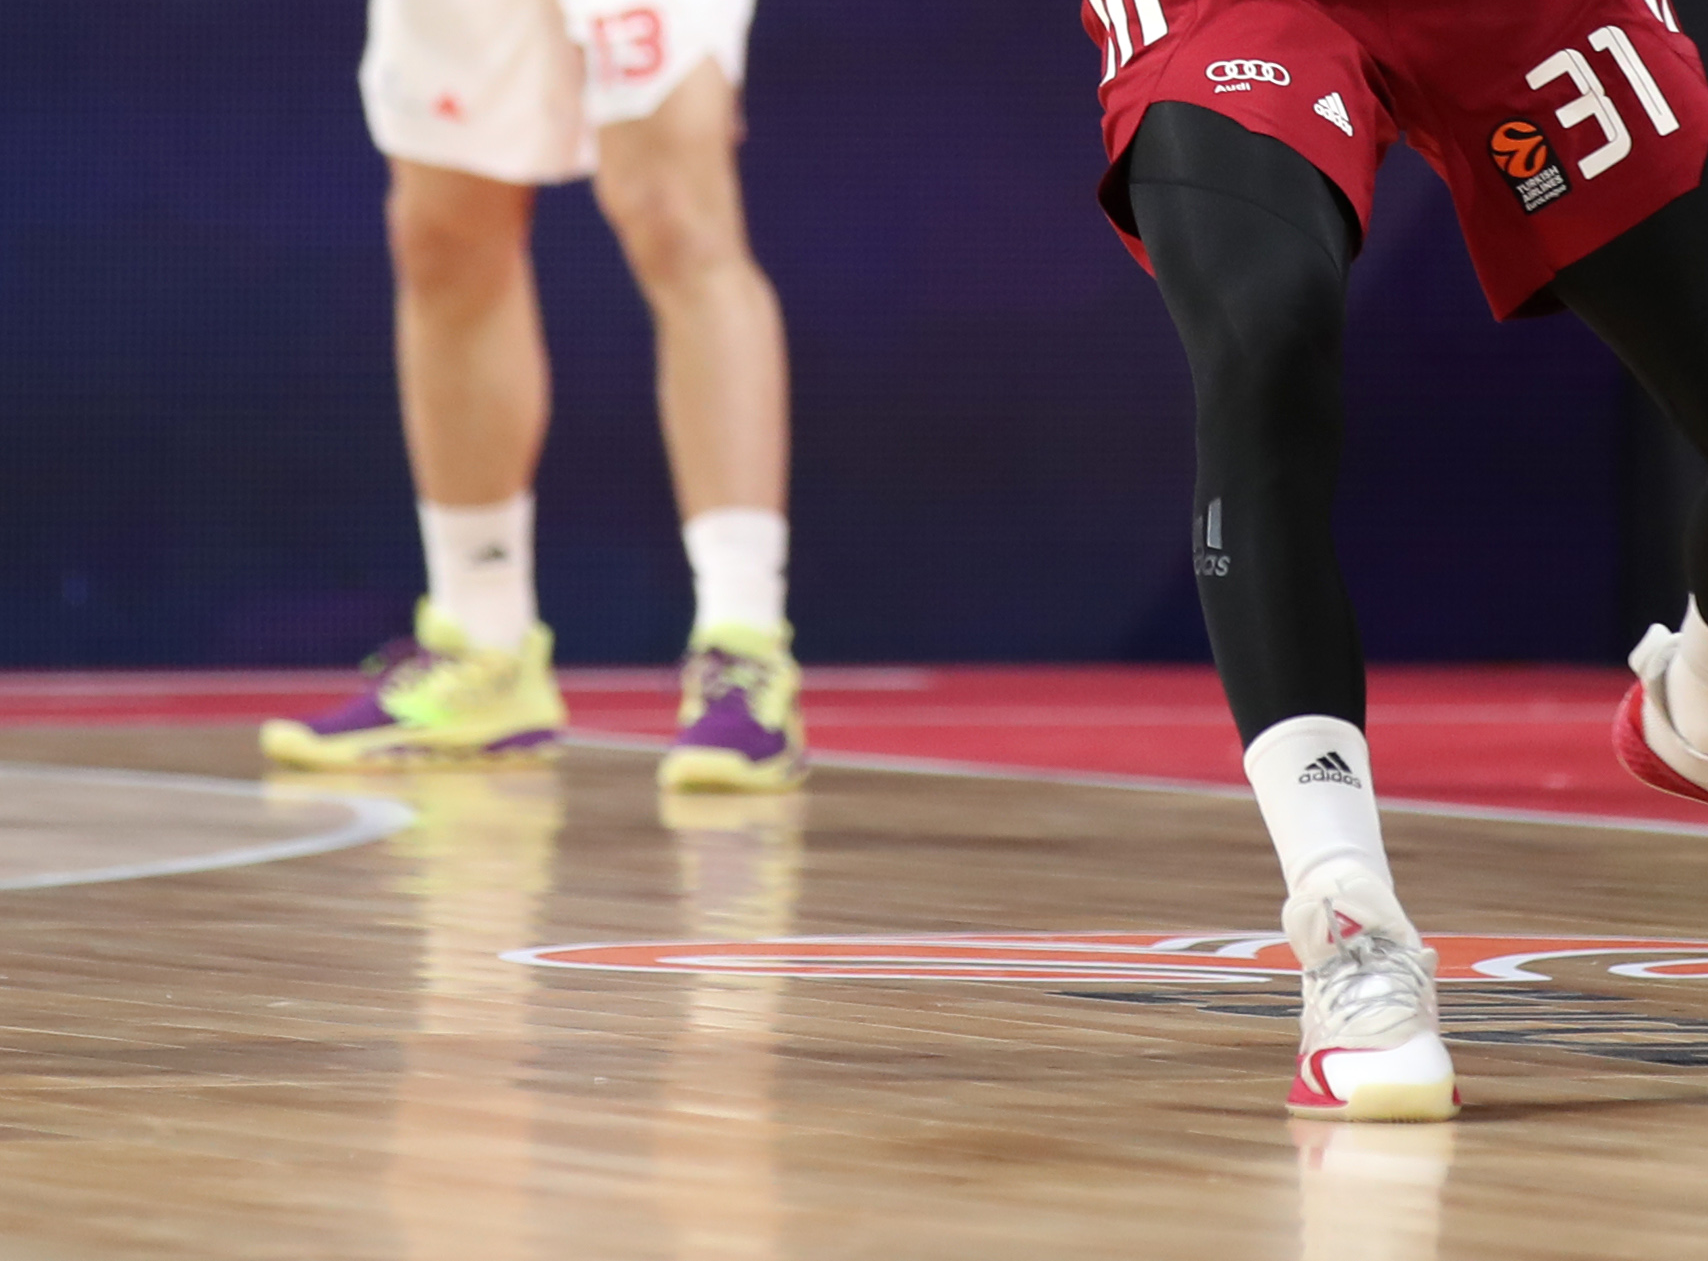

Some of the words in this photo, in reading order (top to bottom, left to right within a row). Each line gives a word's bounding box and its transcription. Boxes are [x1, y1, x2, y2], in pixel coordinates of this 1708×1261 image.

[1214, 82, 1251, 94] Audi
[1525, 25, 1680, 180] 31
[1516, 164, 1560, 195] TURKISH
[1522, 174, 1564, 203] AIRLINES
[1298, 769, 1362, 789] adidas
